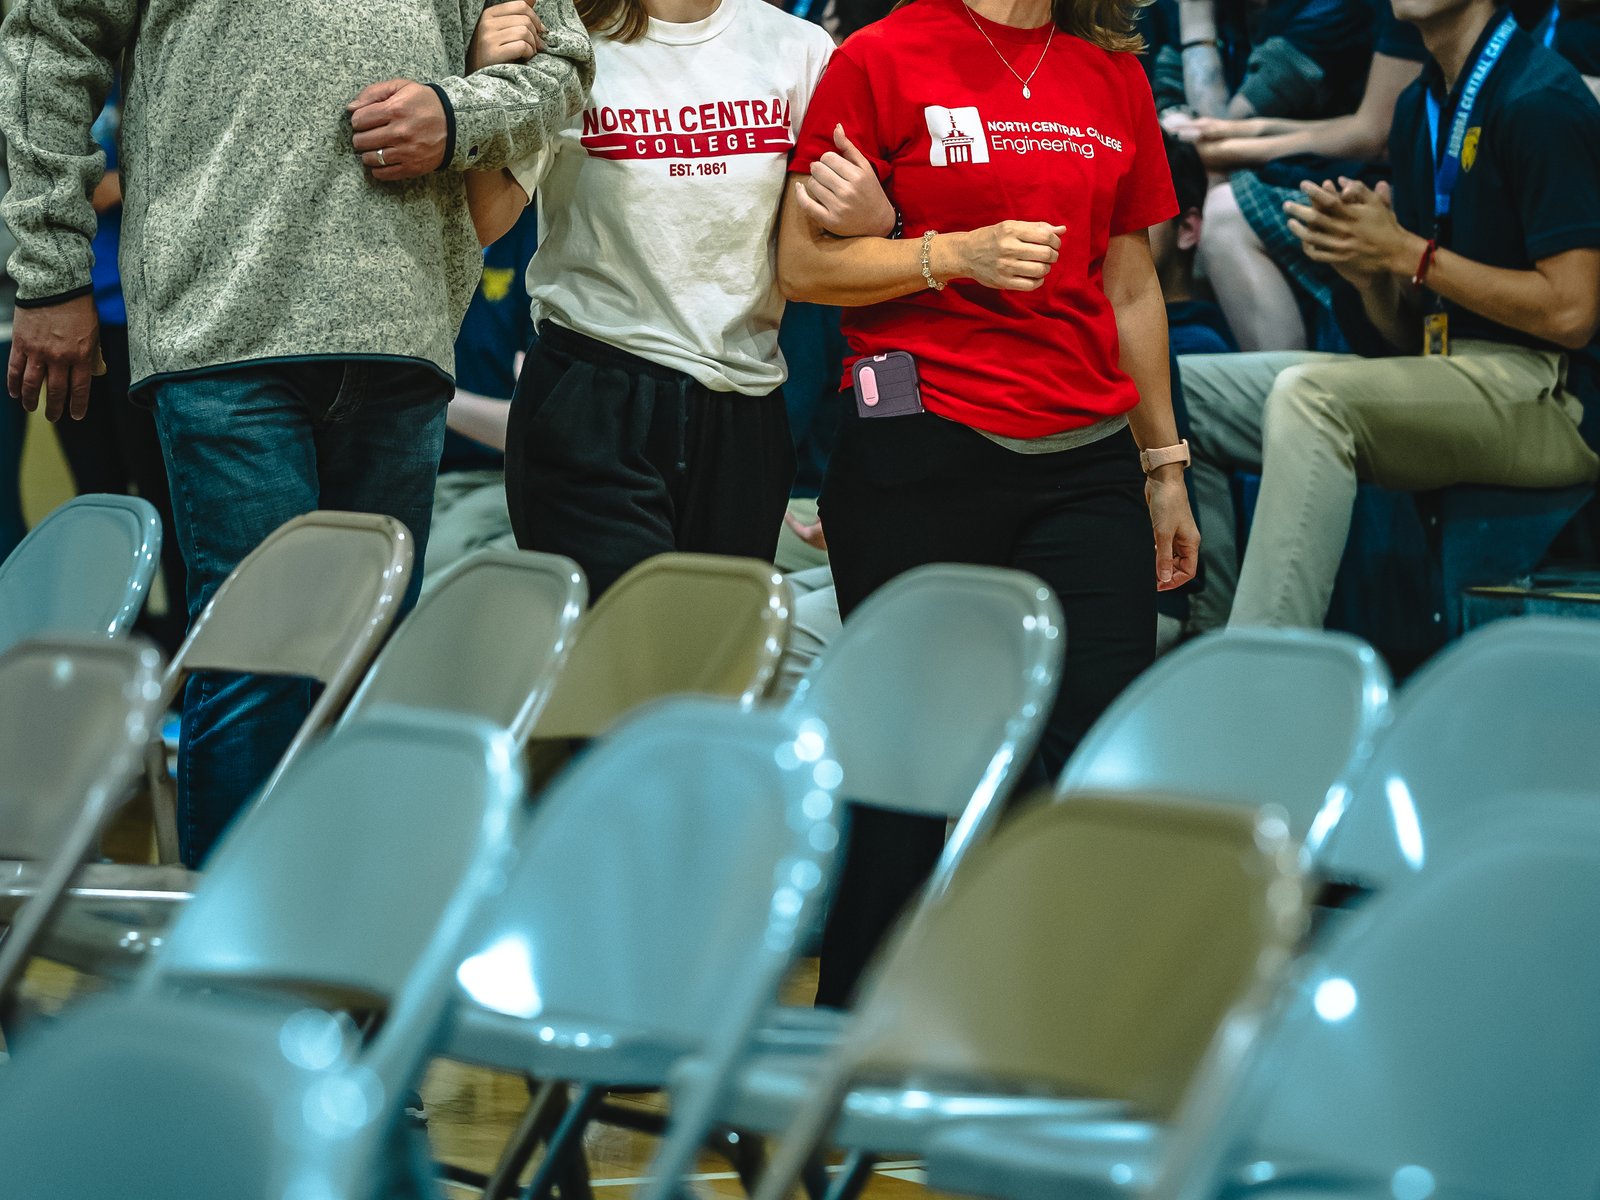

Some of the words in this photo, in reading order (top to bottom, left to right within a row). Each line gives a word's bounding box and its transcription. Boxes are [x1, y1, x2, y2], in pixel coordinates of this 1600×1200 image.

[1460, 59, 1492, 110] CENTRAL
[582, 106, 672, 136] NORTH
[679, 98, 791, 132] CENTRAL
[987, 121, 1030, 133] NORTH
[1031, 121, 1085, 137] CENTRAL
[635, 132, 756, 155] COLLEGE
[991, 135, 1095, 159] Engineering
[669, 163, 695, 177] EST.
[696, 161, 727, 176] 1861
